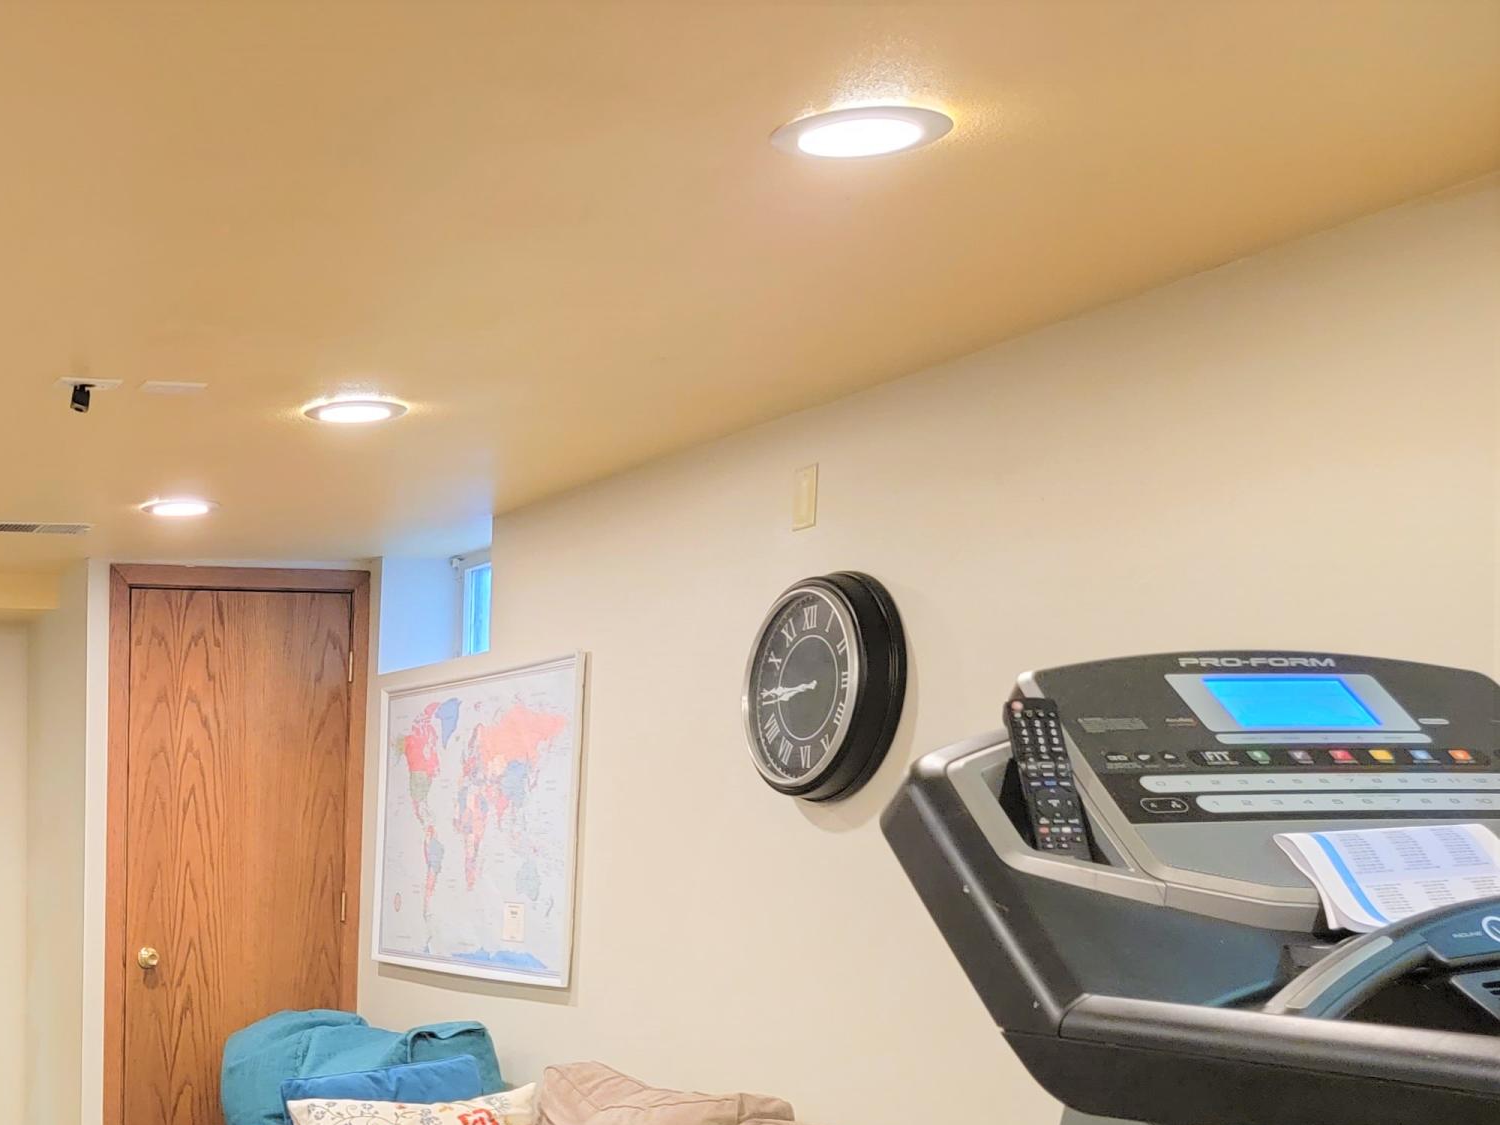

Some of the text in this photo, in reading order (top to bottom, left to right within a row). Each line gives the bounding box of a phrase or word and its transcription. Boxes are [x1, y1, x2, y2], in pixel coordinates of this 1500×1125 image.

[802, 604, 818, 631] XII
[781, 619, 797, 648] XI
[768, 651, 782, 671] X
[1178, 657, 1336, 667] PRO-FORM
[799, 745, 811, 769] VI
